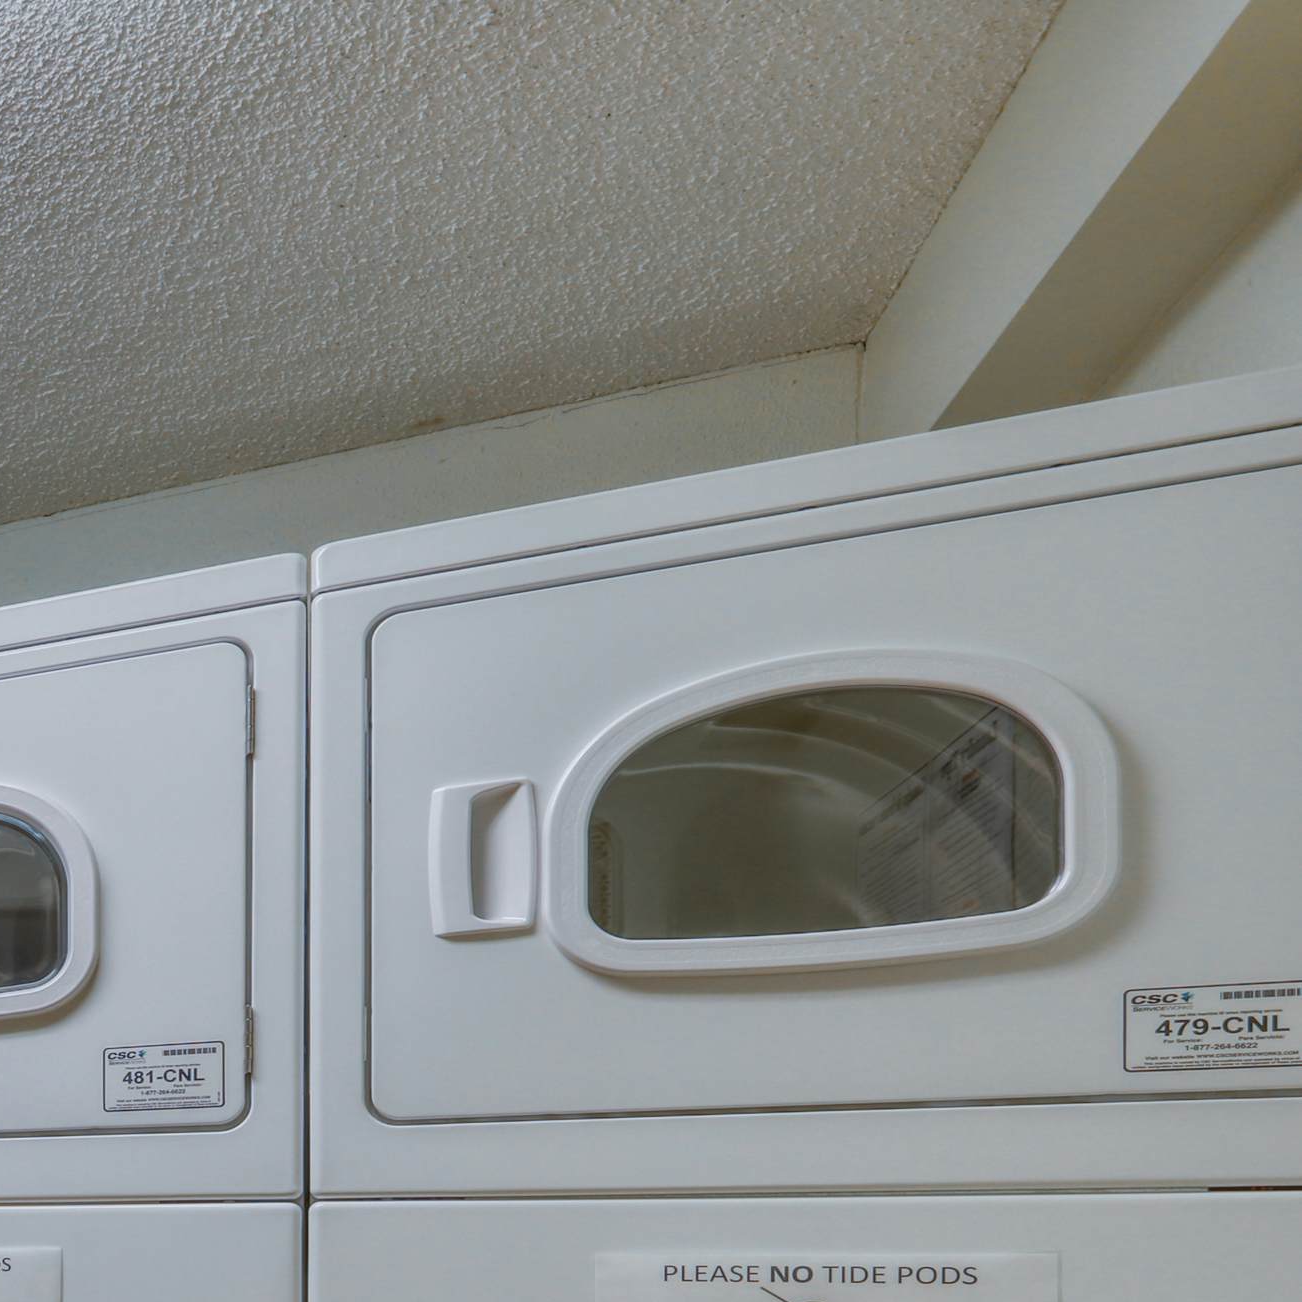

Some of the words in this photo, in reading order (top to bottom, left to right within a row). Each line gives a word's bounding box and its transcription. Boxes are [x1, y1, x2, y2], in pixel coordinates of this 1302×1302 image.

[1131, 994, 1179, 1005] CSC
[1155, 1014, 1291, 1036] 479-CNL
[108, 1051, 137, 1060] CSC
[123, 1068, 205, 1084] 481-CNL
[664, 1265, 759, 1282] PLEASE
[770, 1266, 813, 1283] NO
[822, 1266, 887, 1284] TIDE
[898, 1266, 979, 1285] PODS
